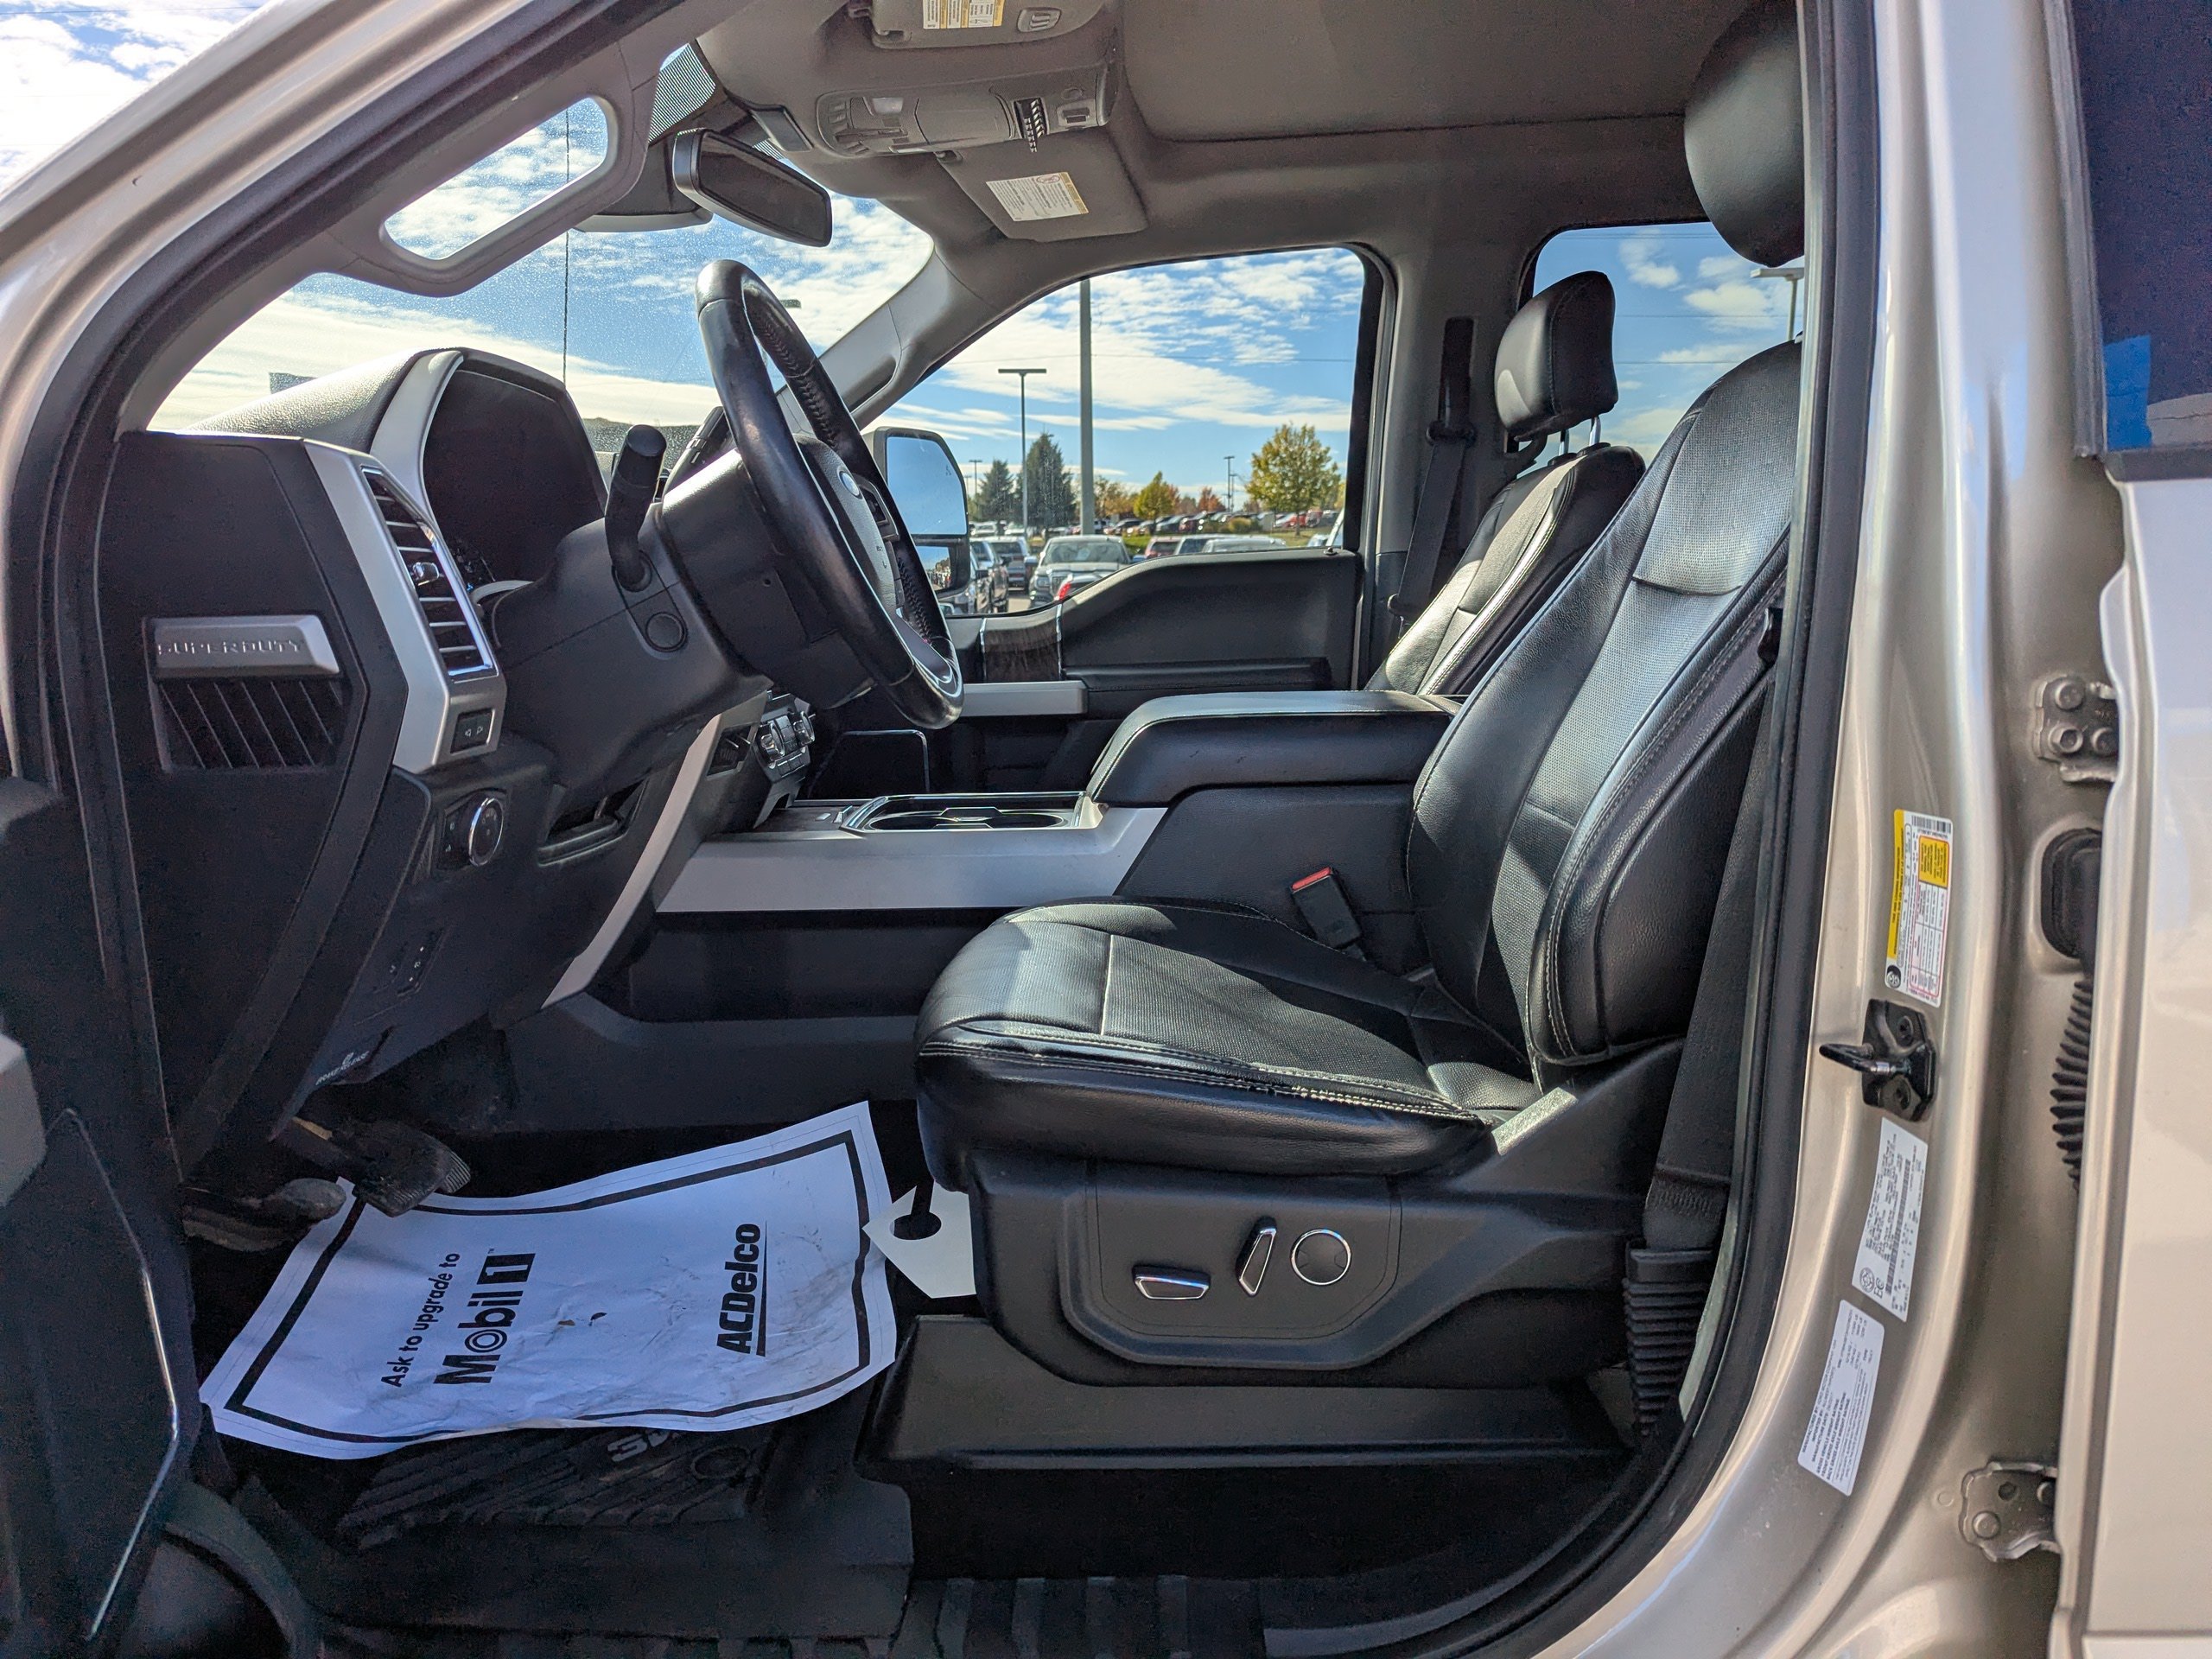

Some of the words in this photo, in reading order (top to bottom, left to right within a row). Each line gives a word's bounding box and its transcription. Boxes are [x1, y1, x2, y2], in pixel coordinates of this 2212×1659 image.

[381, 1356, 414, 1388] Ask
[398, 1335, 423, 1351] to
[413, 1273, 453, 1331] upgrade
[439, 1253, 461, 1267] to
[433, 1290, 524, 1384] Mobil
[716, 1224, 761, 1354] ACDelco
